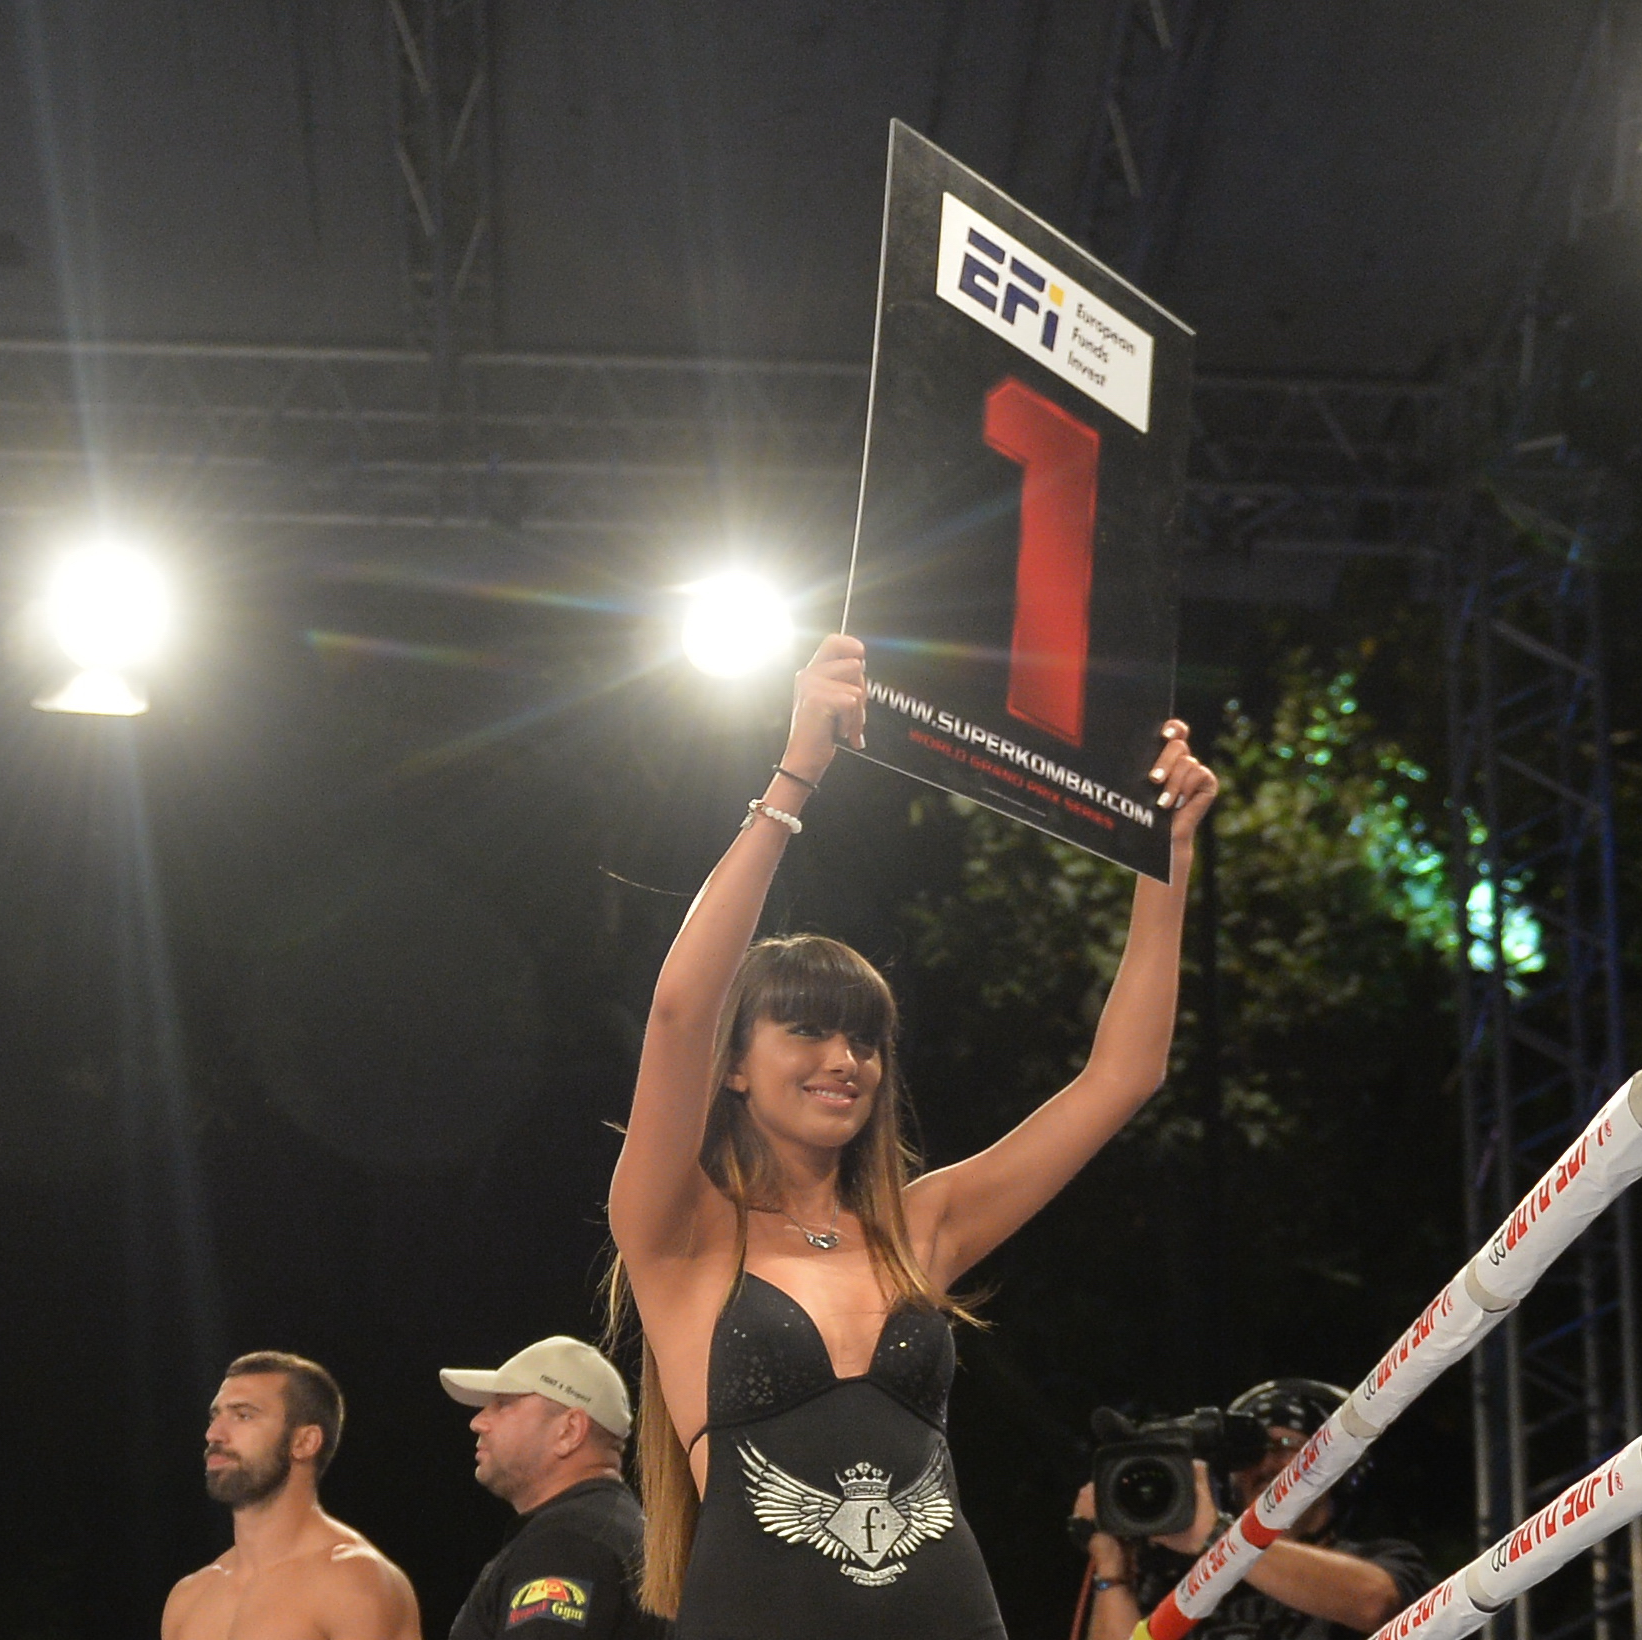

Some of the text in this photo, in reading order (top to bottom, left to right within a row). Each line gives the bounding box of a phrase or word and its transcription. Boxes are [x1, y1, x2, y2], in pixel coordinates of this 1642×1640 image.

[1072, 327, 1110, 365] Funds
[1076, 303, 1135, 356] European
[1067, 350, 1107, 388] Invest
[983, 376, 1100, 747] 1
[866, 678, 1154, 829] WWW.SUPERKOMBAT.COM
